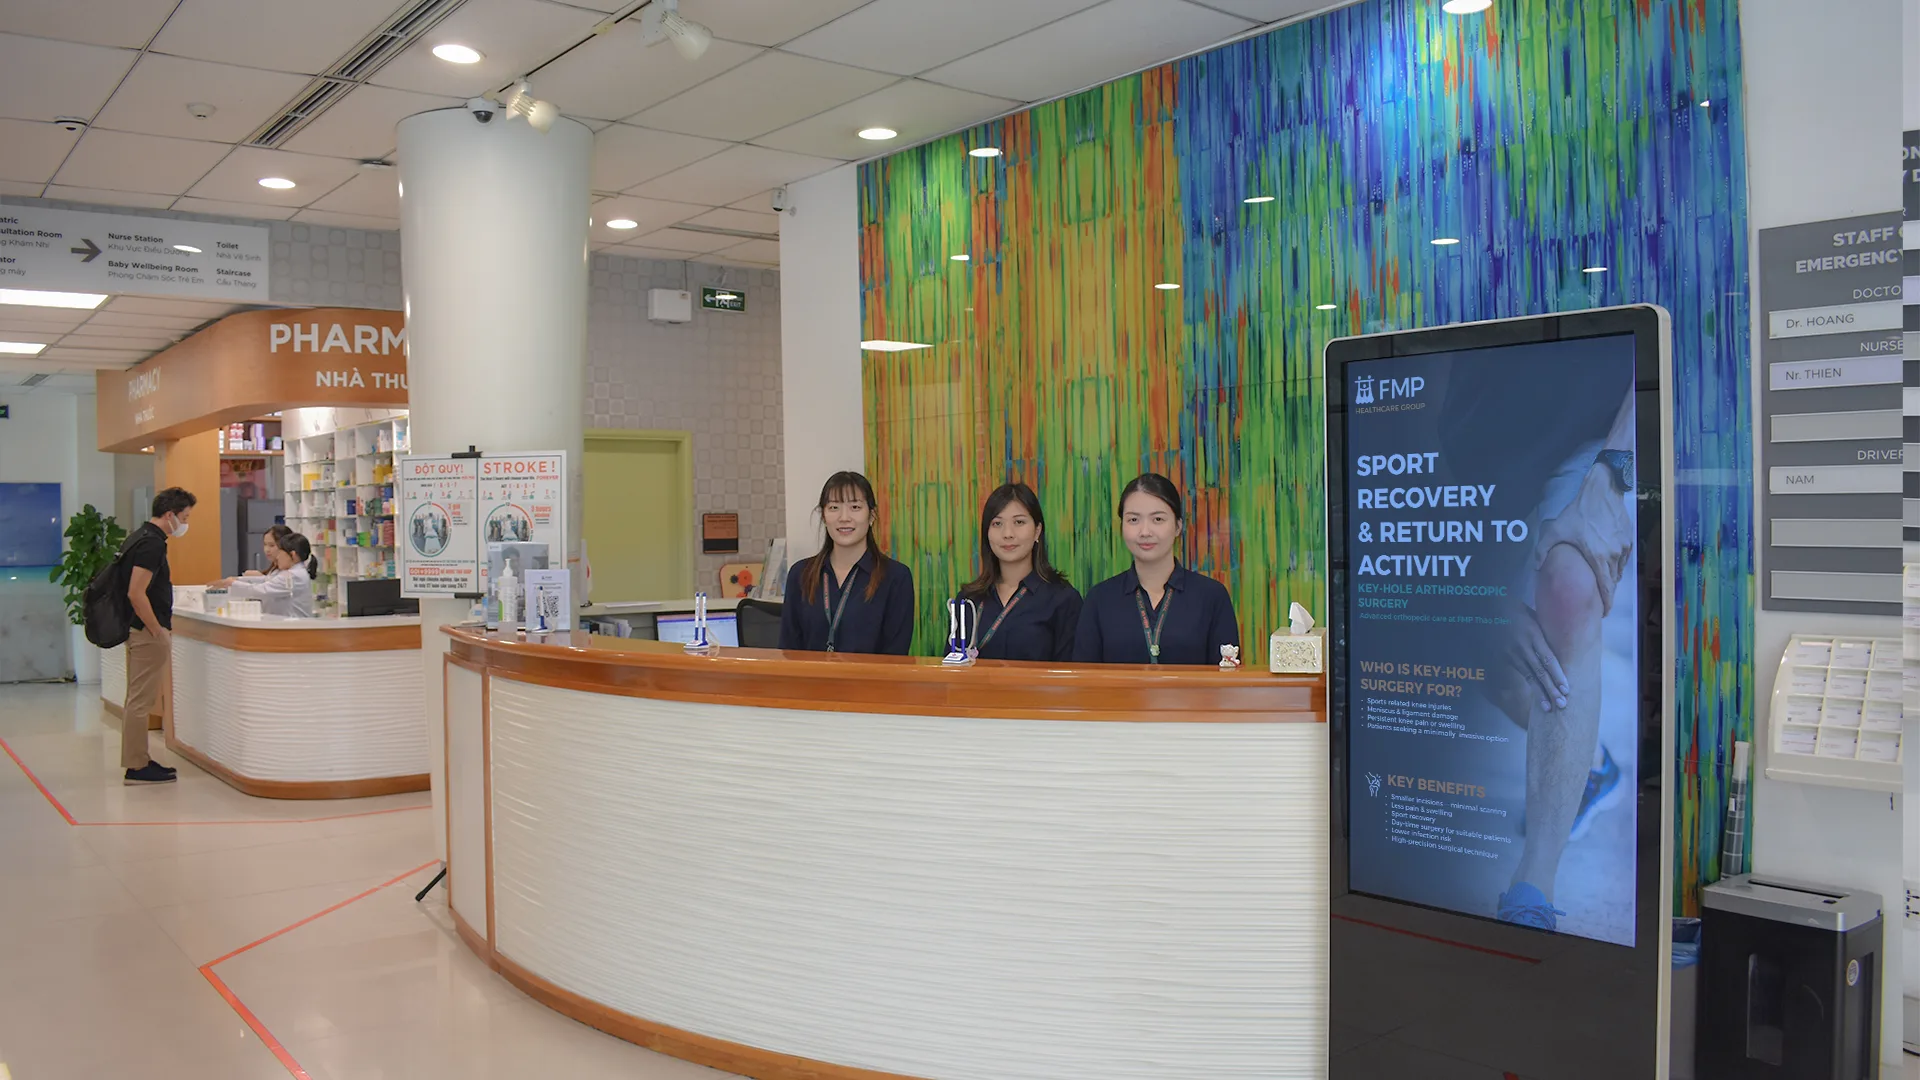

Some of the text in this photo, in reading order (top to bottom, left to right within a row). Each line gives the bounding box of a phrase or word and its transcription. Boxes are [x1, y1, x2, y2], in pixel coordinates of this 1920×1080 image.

[0, 228, 62, 238] ultation Room
[108, 232, 164, 244] Nurse Station
[1833, 227, 1894, 246] STAFF
[216, 242, 238, 250] Toilet
[108, 260, 128, 269] Baby
[132, 262, 172, 272] Wellbeing
[216, 268, 252, 276] Staircase
[1786, 314, 1854, 328] Dr. HOANG
[270, 323, 406, 356] PHARM
[316, 367, 365, 388] NHÀ
[1786, 368, 1842, 380] Nr. THIEN
[1380, 376, 1424, 400] FMP
[1356, 402, 1426, 414] HEALTHCARE GROUP
[415, 462, 435, 476] ĐỘT
[1357, 452, 1439, 476] SPORT
[1786, 475, 1814, 484] NAM
[1358, 484, 1496, 509] RECOVERY
[1358, 520, 1528, 543] & RETURN TO
[1358, 554, 1472, 577] ACTIVITY
[1358, 584, 1508, 596] KEY-HOLE ARTHROSCOPIC
[1358, 598, 1408, 608] SURGERY
[1394, 613, 1430, 622] orthopedic
[1360, 661, 1485, 680] WHO IS KEY-HOLE
[1360, 679, 1462, 697] SURGERY FOR?
[1368, 706, 1396, 714] Meniscus
[1432, 712, 1458, 721] damage
[1368, 715, 1397, 723] Persistent
[1438, 721, 1466, 730] swelling
[1393, 726, 1417, 734] seeking
[1424, 729, 1456, 738] minimally
[1458, 732, 1485, 740] invasive
[1388, 774, 1486, 798] KEY BENEFITS
[1392, 794, 1506, 817] Smaller incisions minimal scarring
[1410, 814, 1436, 824] recovery
[1426, 808, 1452, 818] swelling
[1392, 819, 1420, 828] Day-time
[1420, 824, 1444, 833] surgery
[1456, 830, 1482, 838] suitable
[1484, 834, 1512, 844] patients
[1412, 831, 1439, 840] infection
[1392, 836, 1498, 858] High-precision surgical technique
